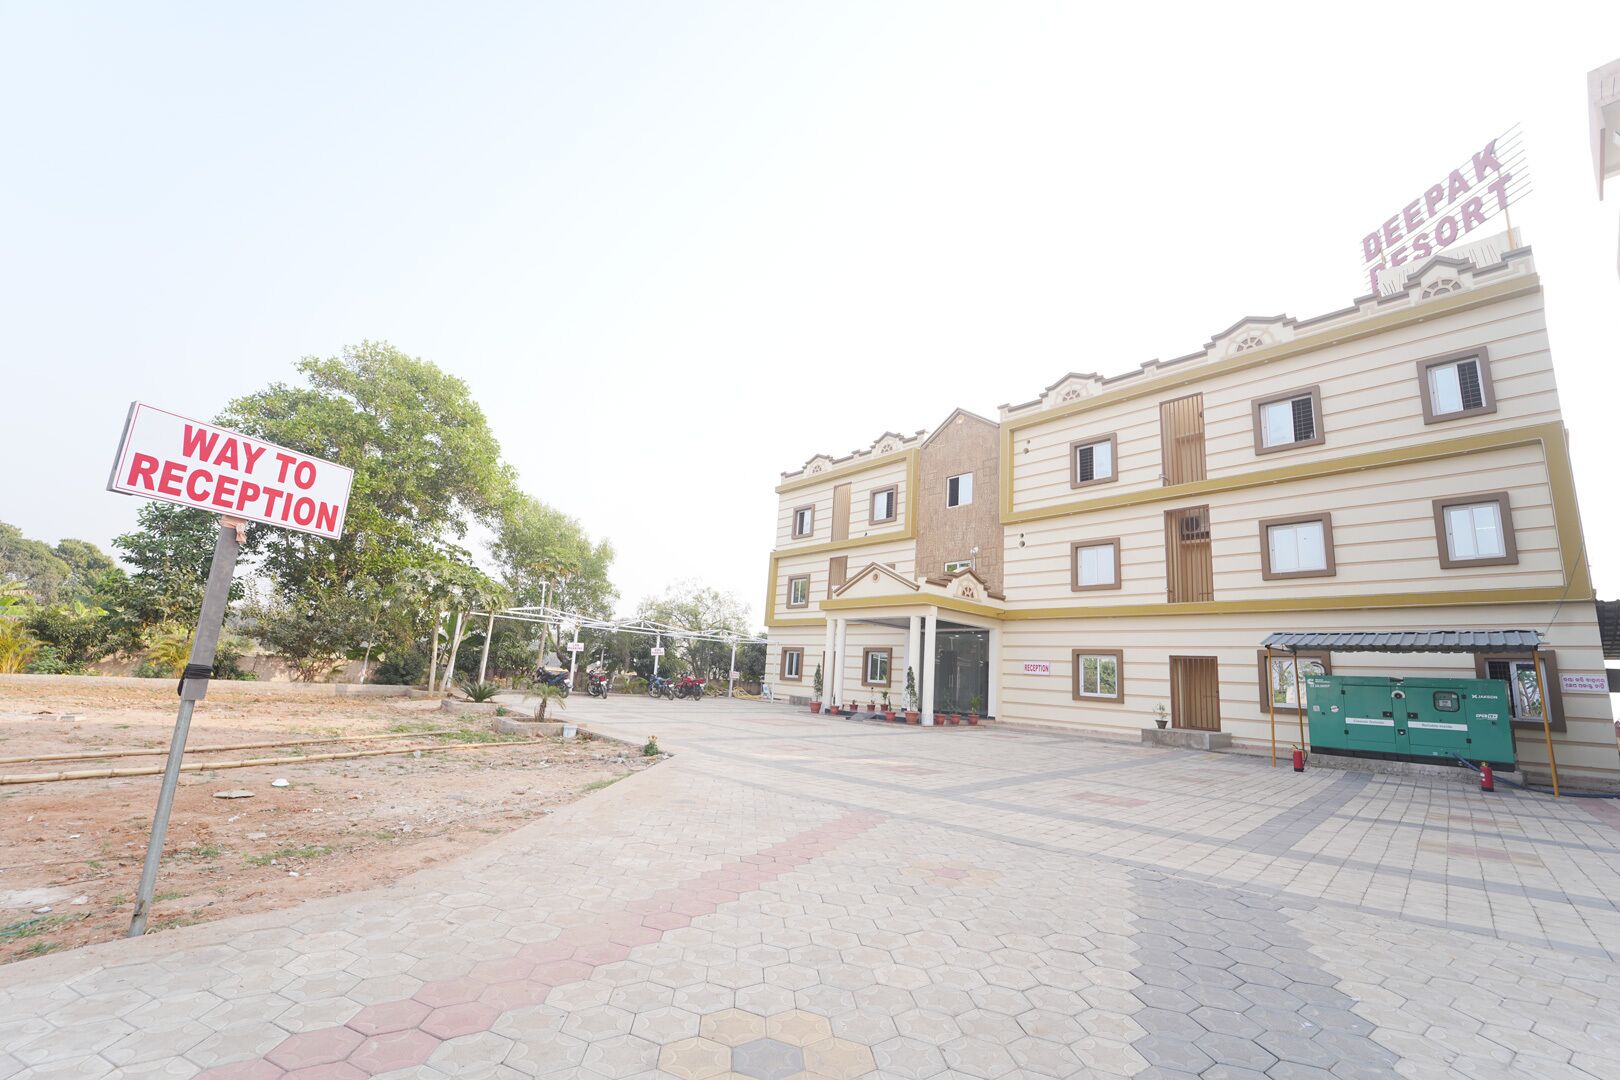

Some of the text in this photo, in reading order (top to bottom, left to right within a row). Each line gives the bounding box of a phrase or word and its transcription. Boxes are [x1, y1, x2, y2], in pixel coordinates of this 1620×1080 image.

[1362, 138, 1503, 263] DEEPAK
[126, 452, 340, 533] RECEPTION
[182, 424, 317, 490] WAY TO
[1024, 664, 1049, 672] RECEPTION
